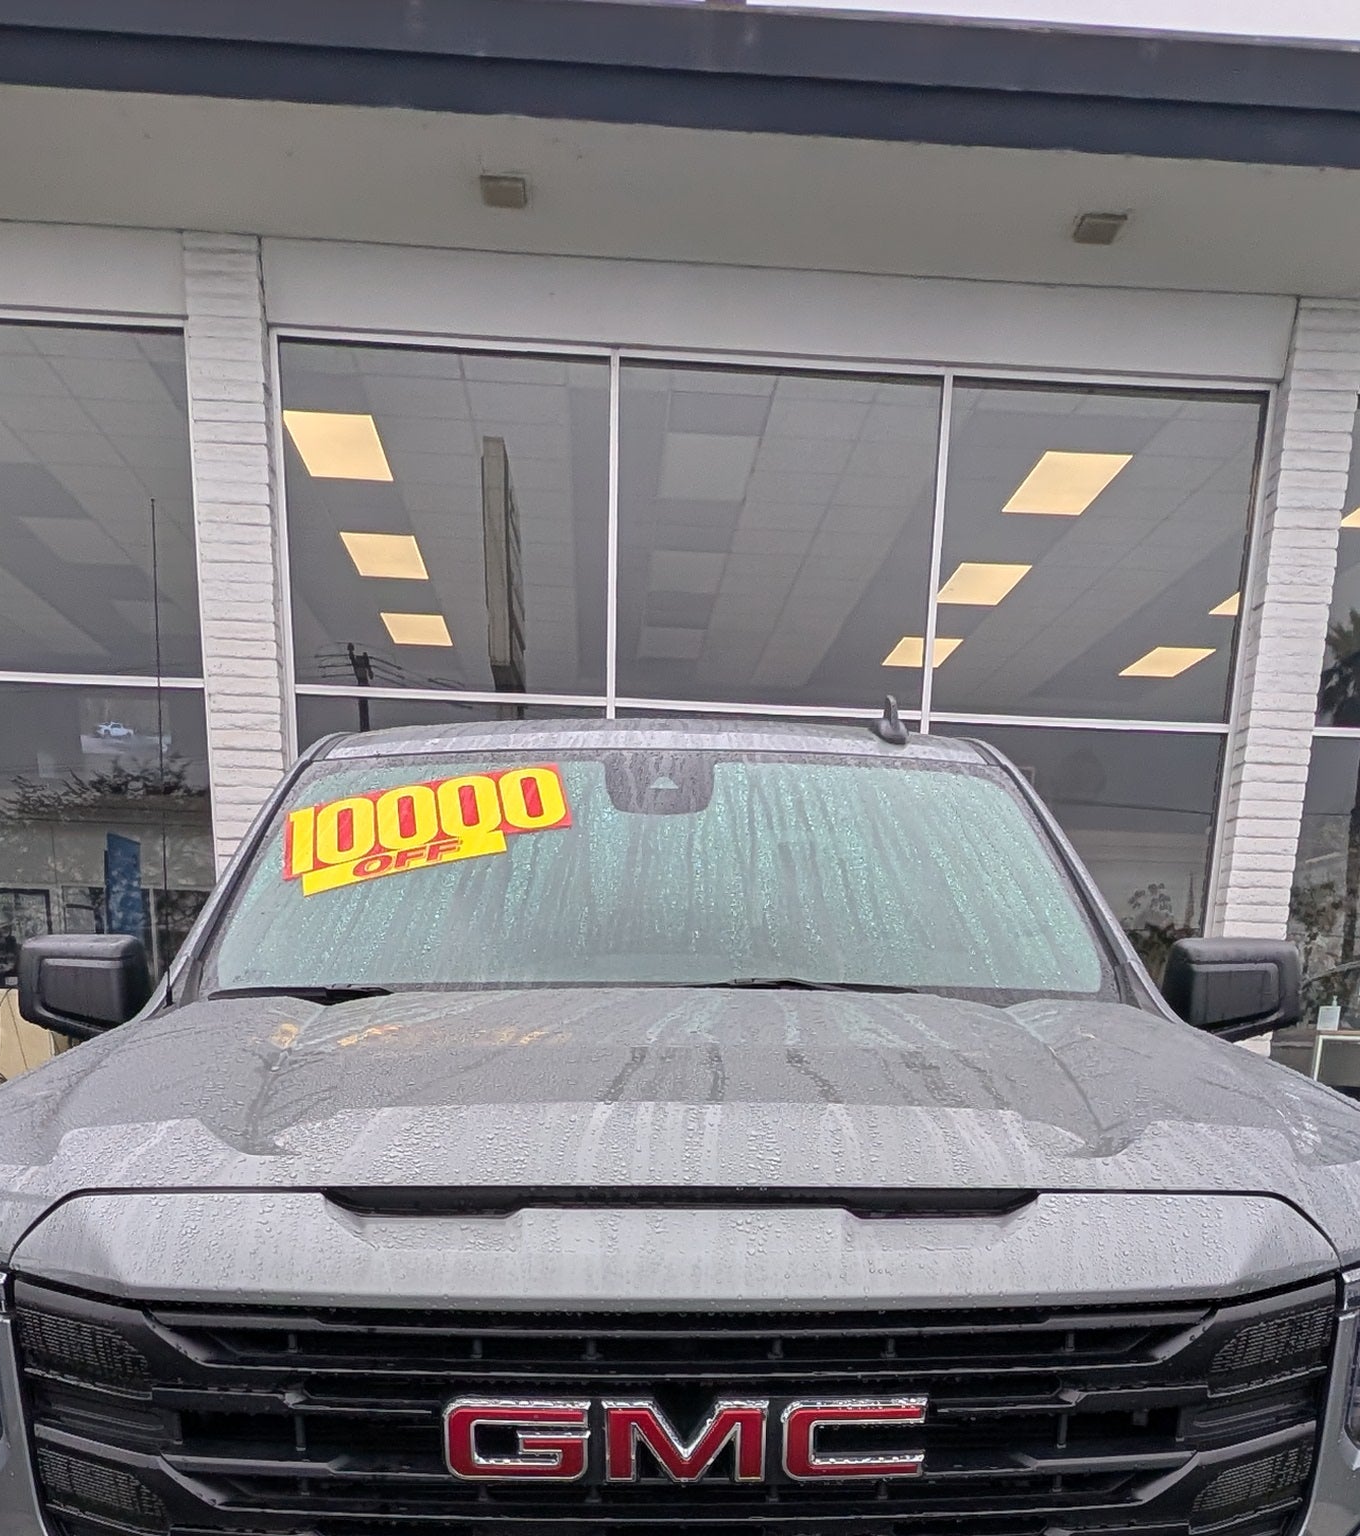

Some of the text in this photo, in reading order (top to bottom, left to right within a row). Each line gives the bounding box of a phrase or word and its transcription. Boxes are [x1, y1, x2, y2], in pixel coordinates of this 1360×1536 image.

[289, 767, 567, 876] 10000
[352, 837, 463, 877] OFF
[442, 1395, 928, 1483] GMC
